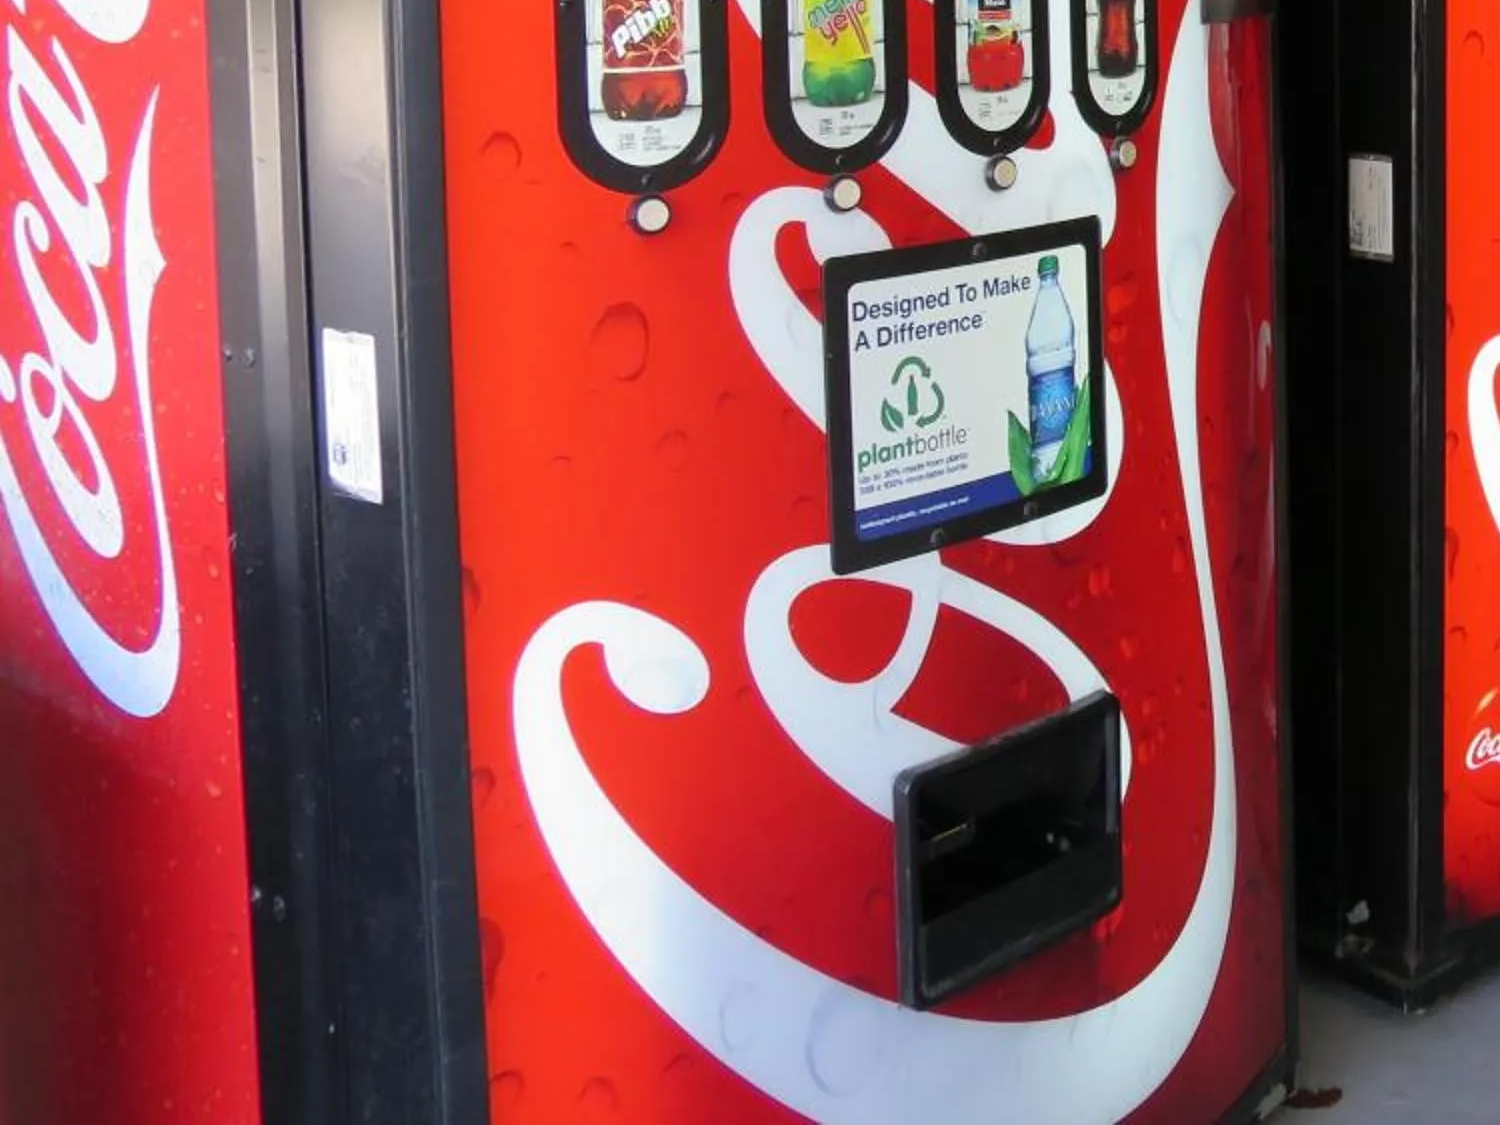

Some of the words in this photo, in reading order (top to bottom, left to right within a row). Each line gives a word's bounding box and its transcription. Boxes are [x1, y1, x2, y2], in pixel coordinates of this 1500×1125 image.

[852, 286, 951, 322] Designed
[955, 283, 977, 304] To
[983, 275, 1031, 299] Make
[854, 330, 871, 352] A
[876, 313, 983, 348] Difference
[857, 424, 967, 473] plantbottle
